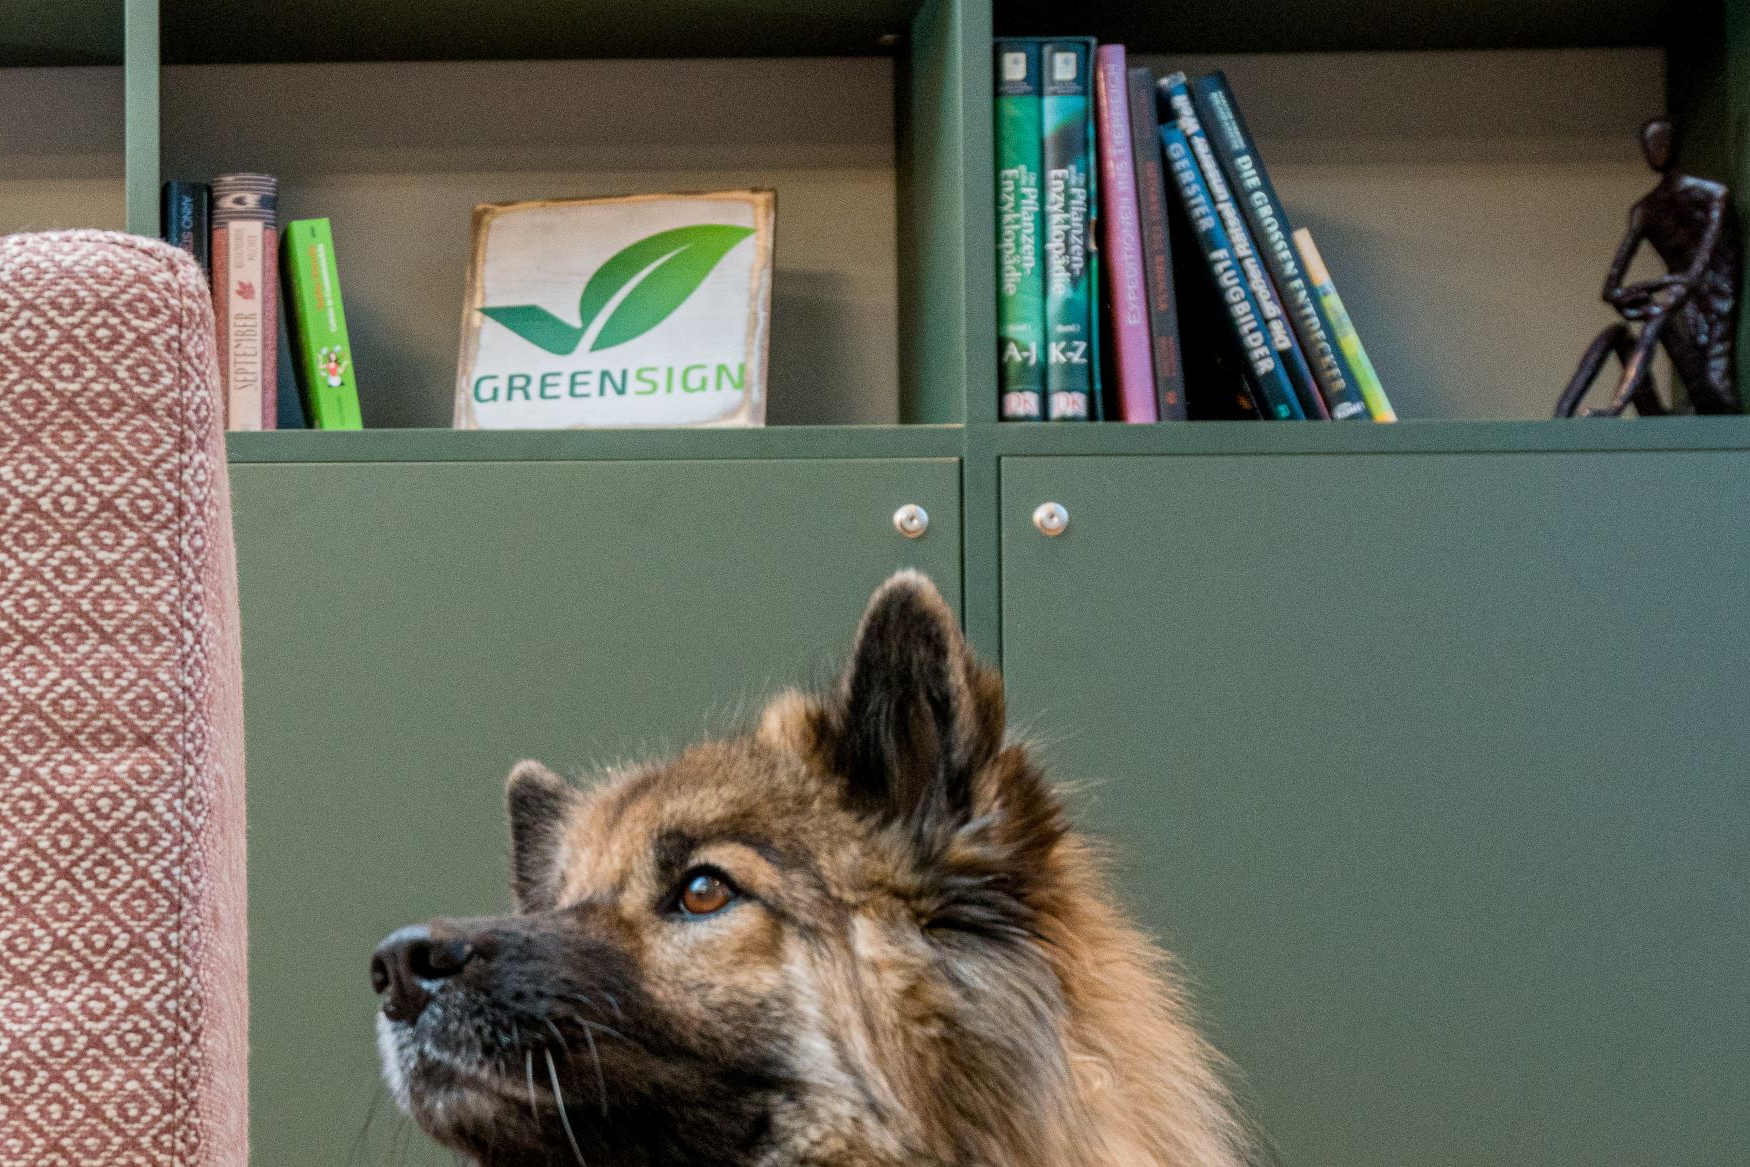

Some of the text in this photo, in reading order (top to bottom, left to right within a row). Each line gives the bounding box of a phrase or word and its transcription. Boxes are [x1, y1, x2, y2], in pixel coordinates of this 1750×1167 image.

[1171, 94, 1201, 137] Welt
[1105, 62, 1141, 325] EXPEDITIONEN INS TIERREICH
[1190, 135, 1230, 203] unserer
[1000, 168, 1023, 296] Enzyklopädie
[1046, 168, 1072, 295] Enzyklopädie
[1167, 142, 1276, 377] GERSTER FLUGBILDER
[1216, 201, 1253, 259] Rätsel
[1234, 154, 1347, 394] DIE GROSSEN ENTDECKER
[1242, 257, 1283, 320] großen
[234, 312, 259, 391] SEPTEMBER
[1003, 340, 1038, 366] A-J
[1049, 340, 1088, 364] K-Z
[1267, 319, 1293, 351] Die
[473, 361, 747, 404] GREENSIGN
